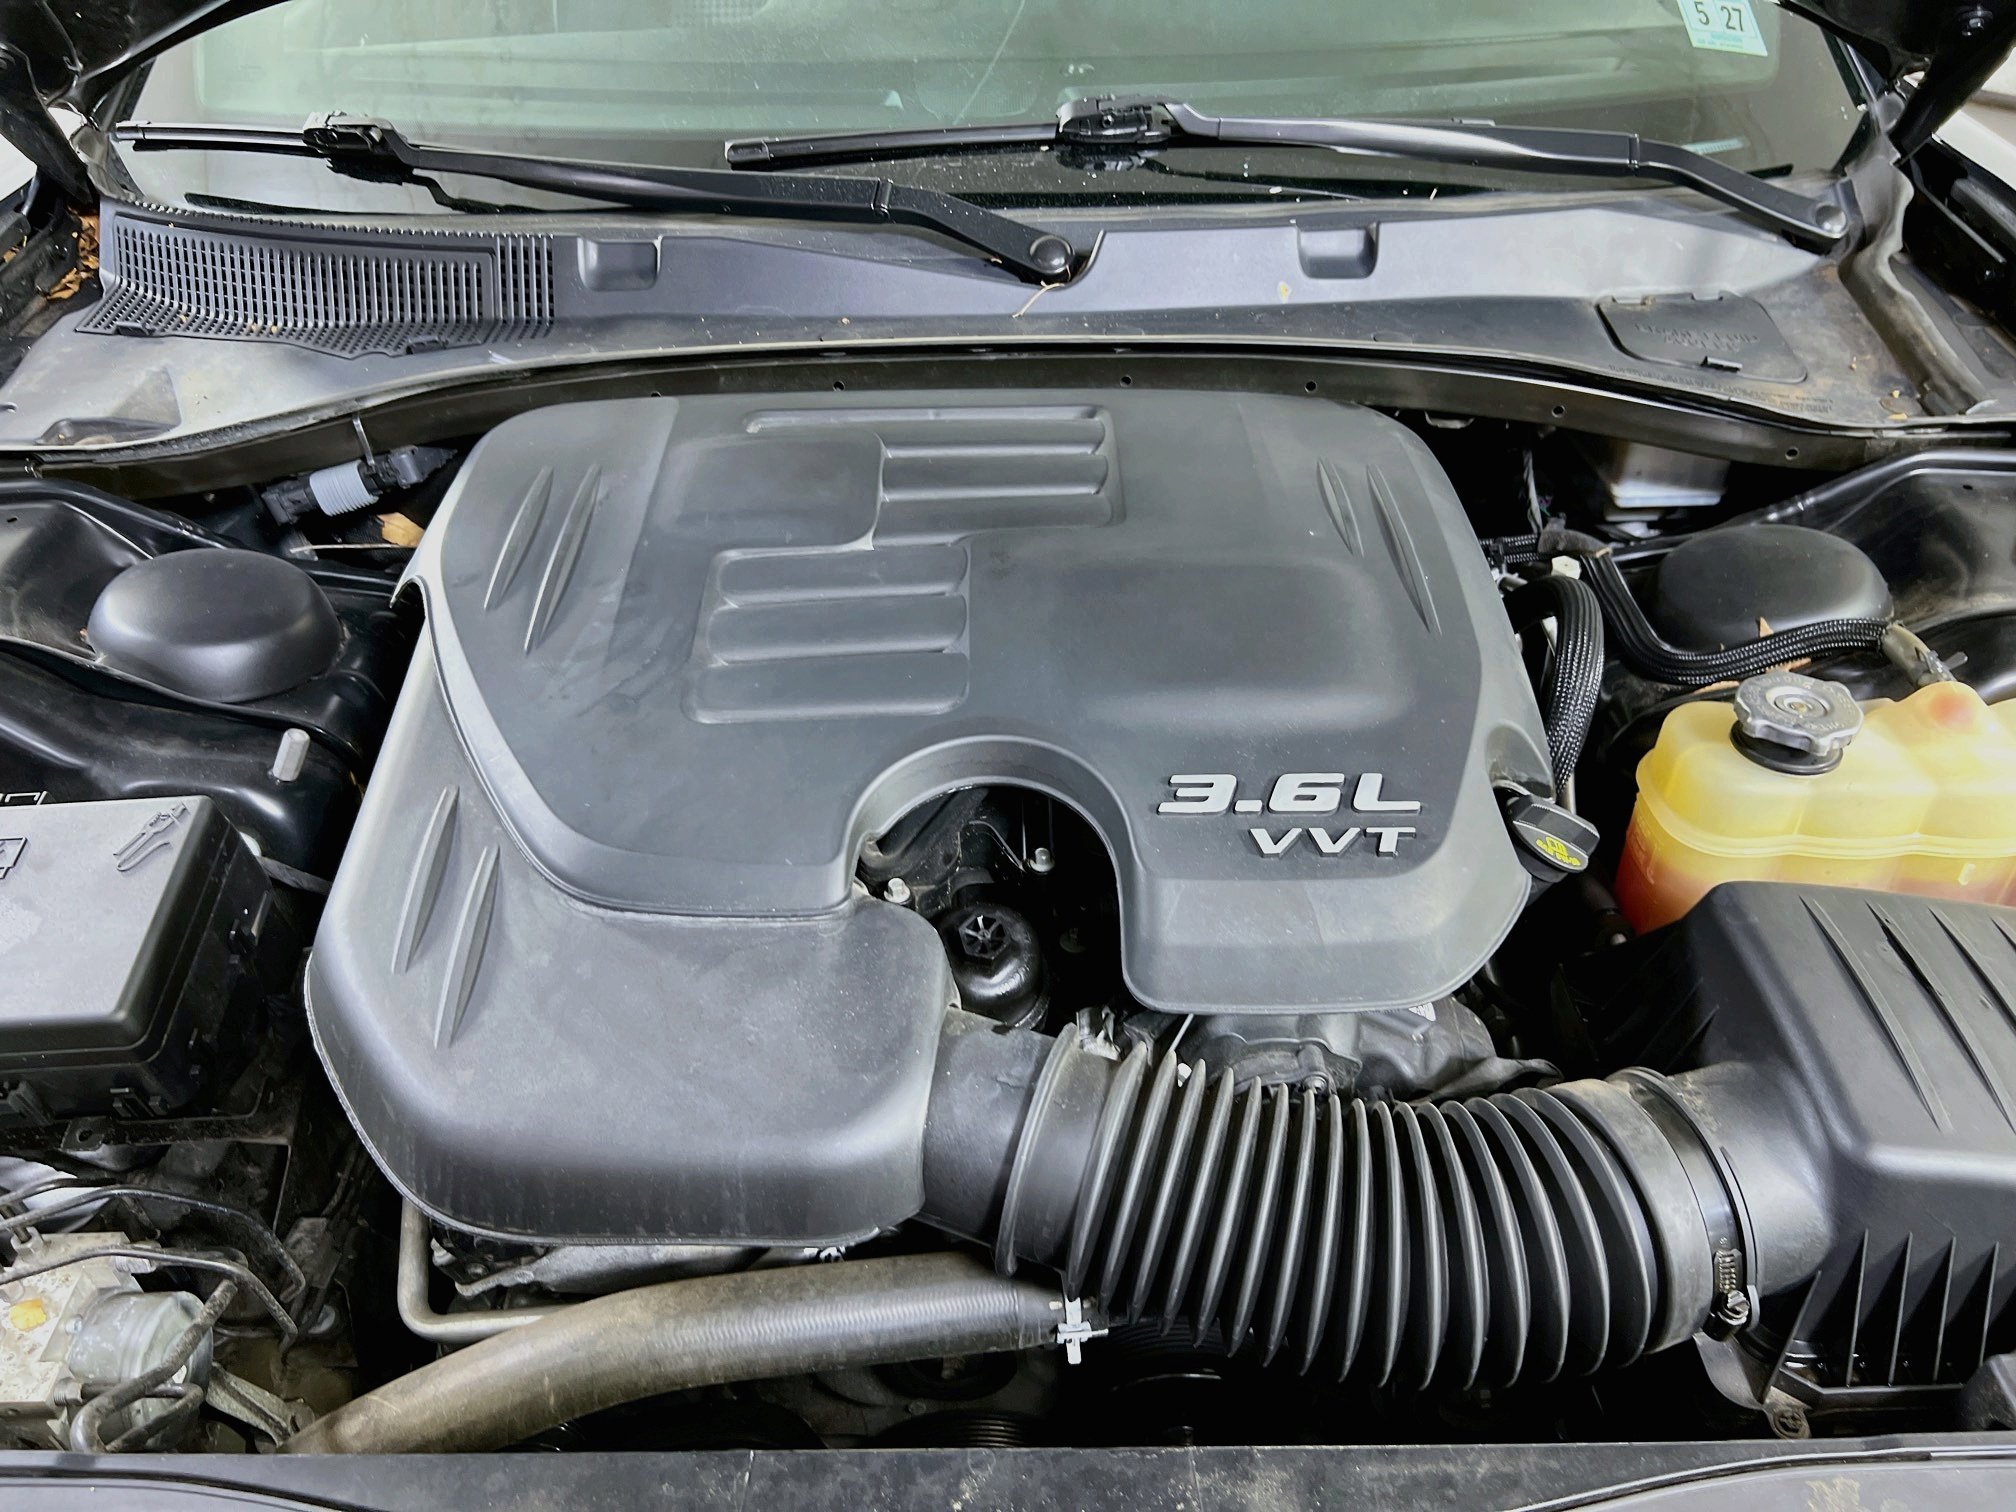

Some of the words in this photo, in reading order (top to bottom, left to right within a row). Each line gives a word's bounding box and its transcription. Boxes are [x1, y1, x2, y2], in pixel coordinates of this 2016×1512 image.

[1694, 1, 1710, 26] 5
[1720, 5, 1744, 31] 27
[1157, 772, 1422, 815] 3.6L
[1249, 826, 1417, 858] VVT
